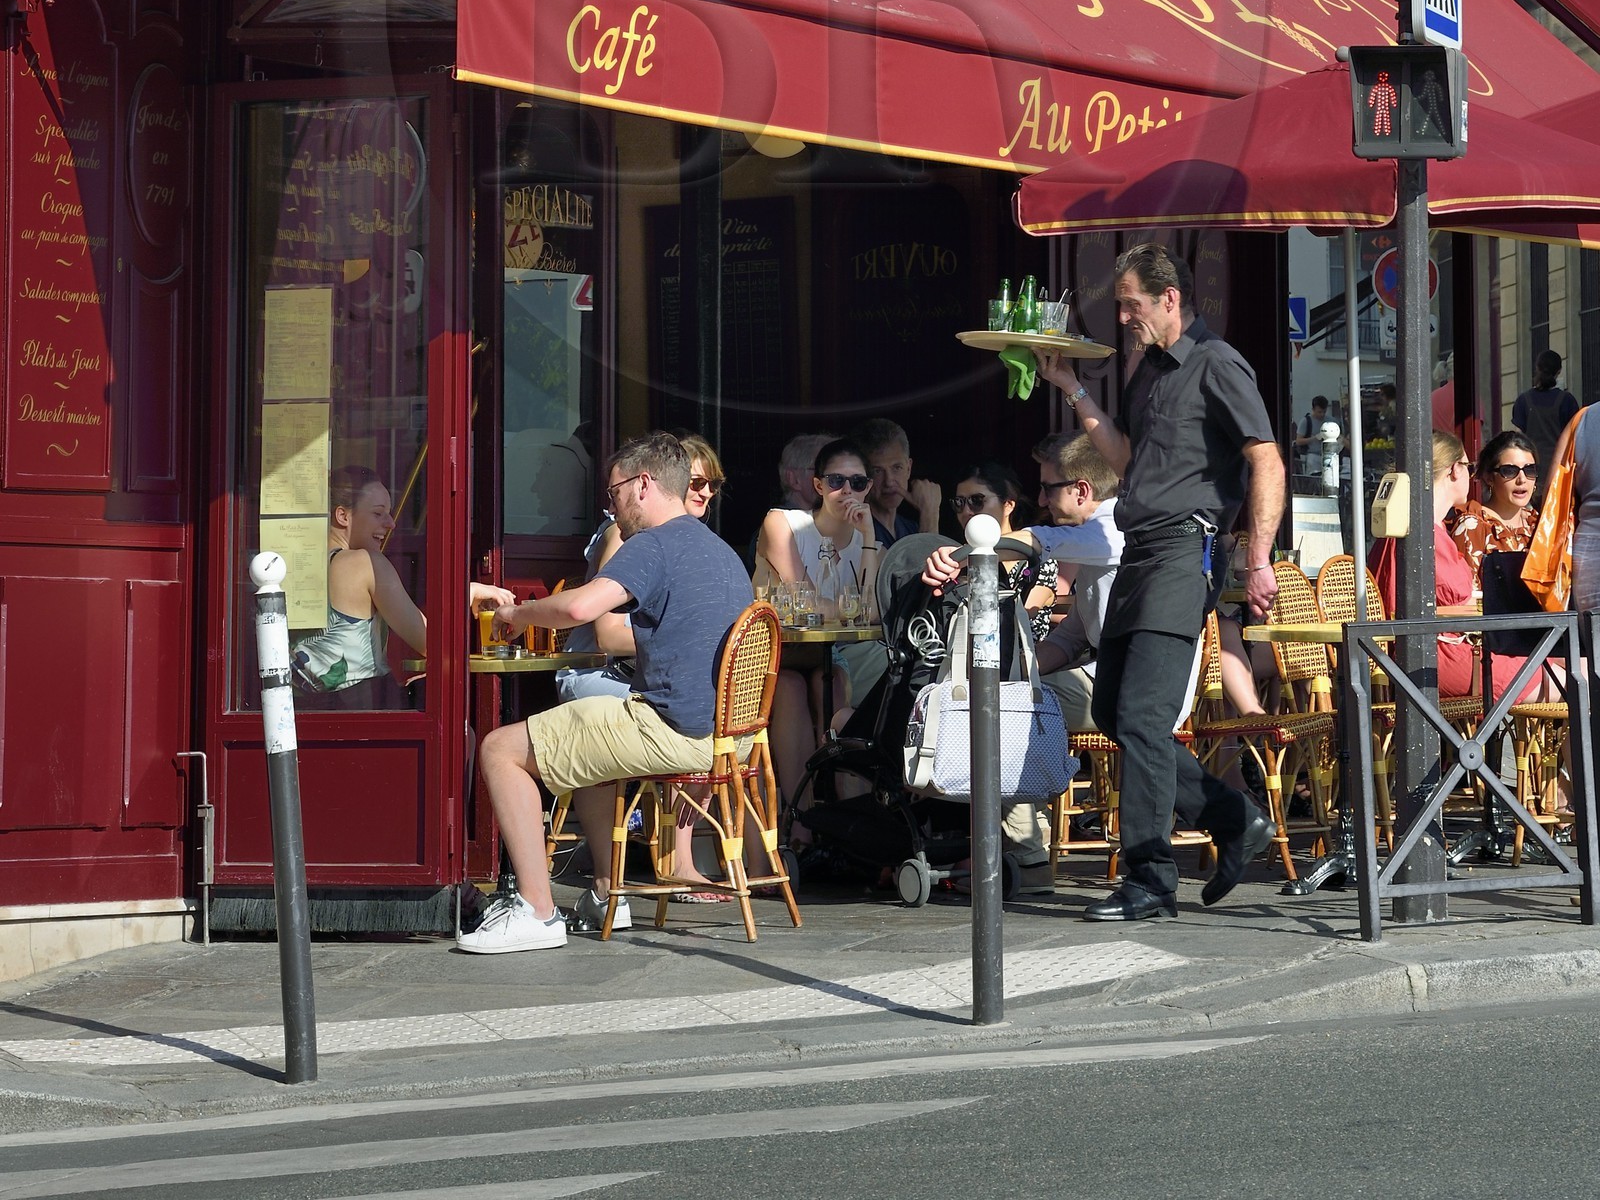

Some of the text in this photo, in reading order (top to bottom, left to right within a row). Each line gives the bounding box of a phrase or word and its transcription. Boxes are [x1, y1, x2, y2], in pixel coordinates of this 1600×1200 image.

[566, 3, 658, 96] Café
[136, 103, 185, 133] Fondé
[998, 76, 1072, 158] Au
[30, 146, 101, 176] sur planche
[152, 150, 170, 166] en
[41, 191, 85, 224] Croque
[144, 182, 176, 206] 1791
[21, 227, 36, 241] au
[35, 226, 60, 251] pain
[1197, 240, 1227, 264] Fondé
[19, 277, 107, 313] Salades composées
[1207, 276, 1218, 287] en
[1201, 295, 1223, 316] 1791
[20, 339, 101, 380] Plats du Jour
[18, 393, 103, 427] Desserts maison
